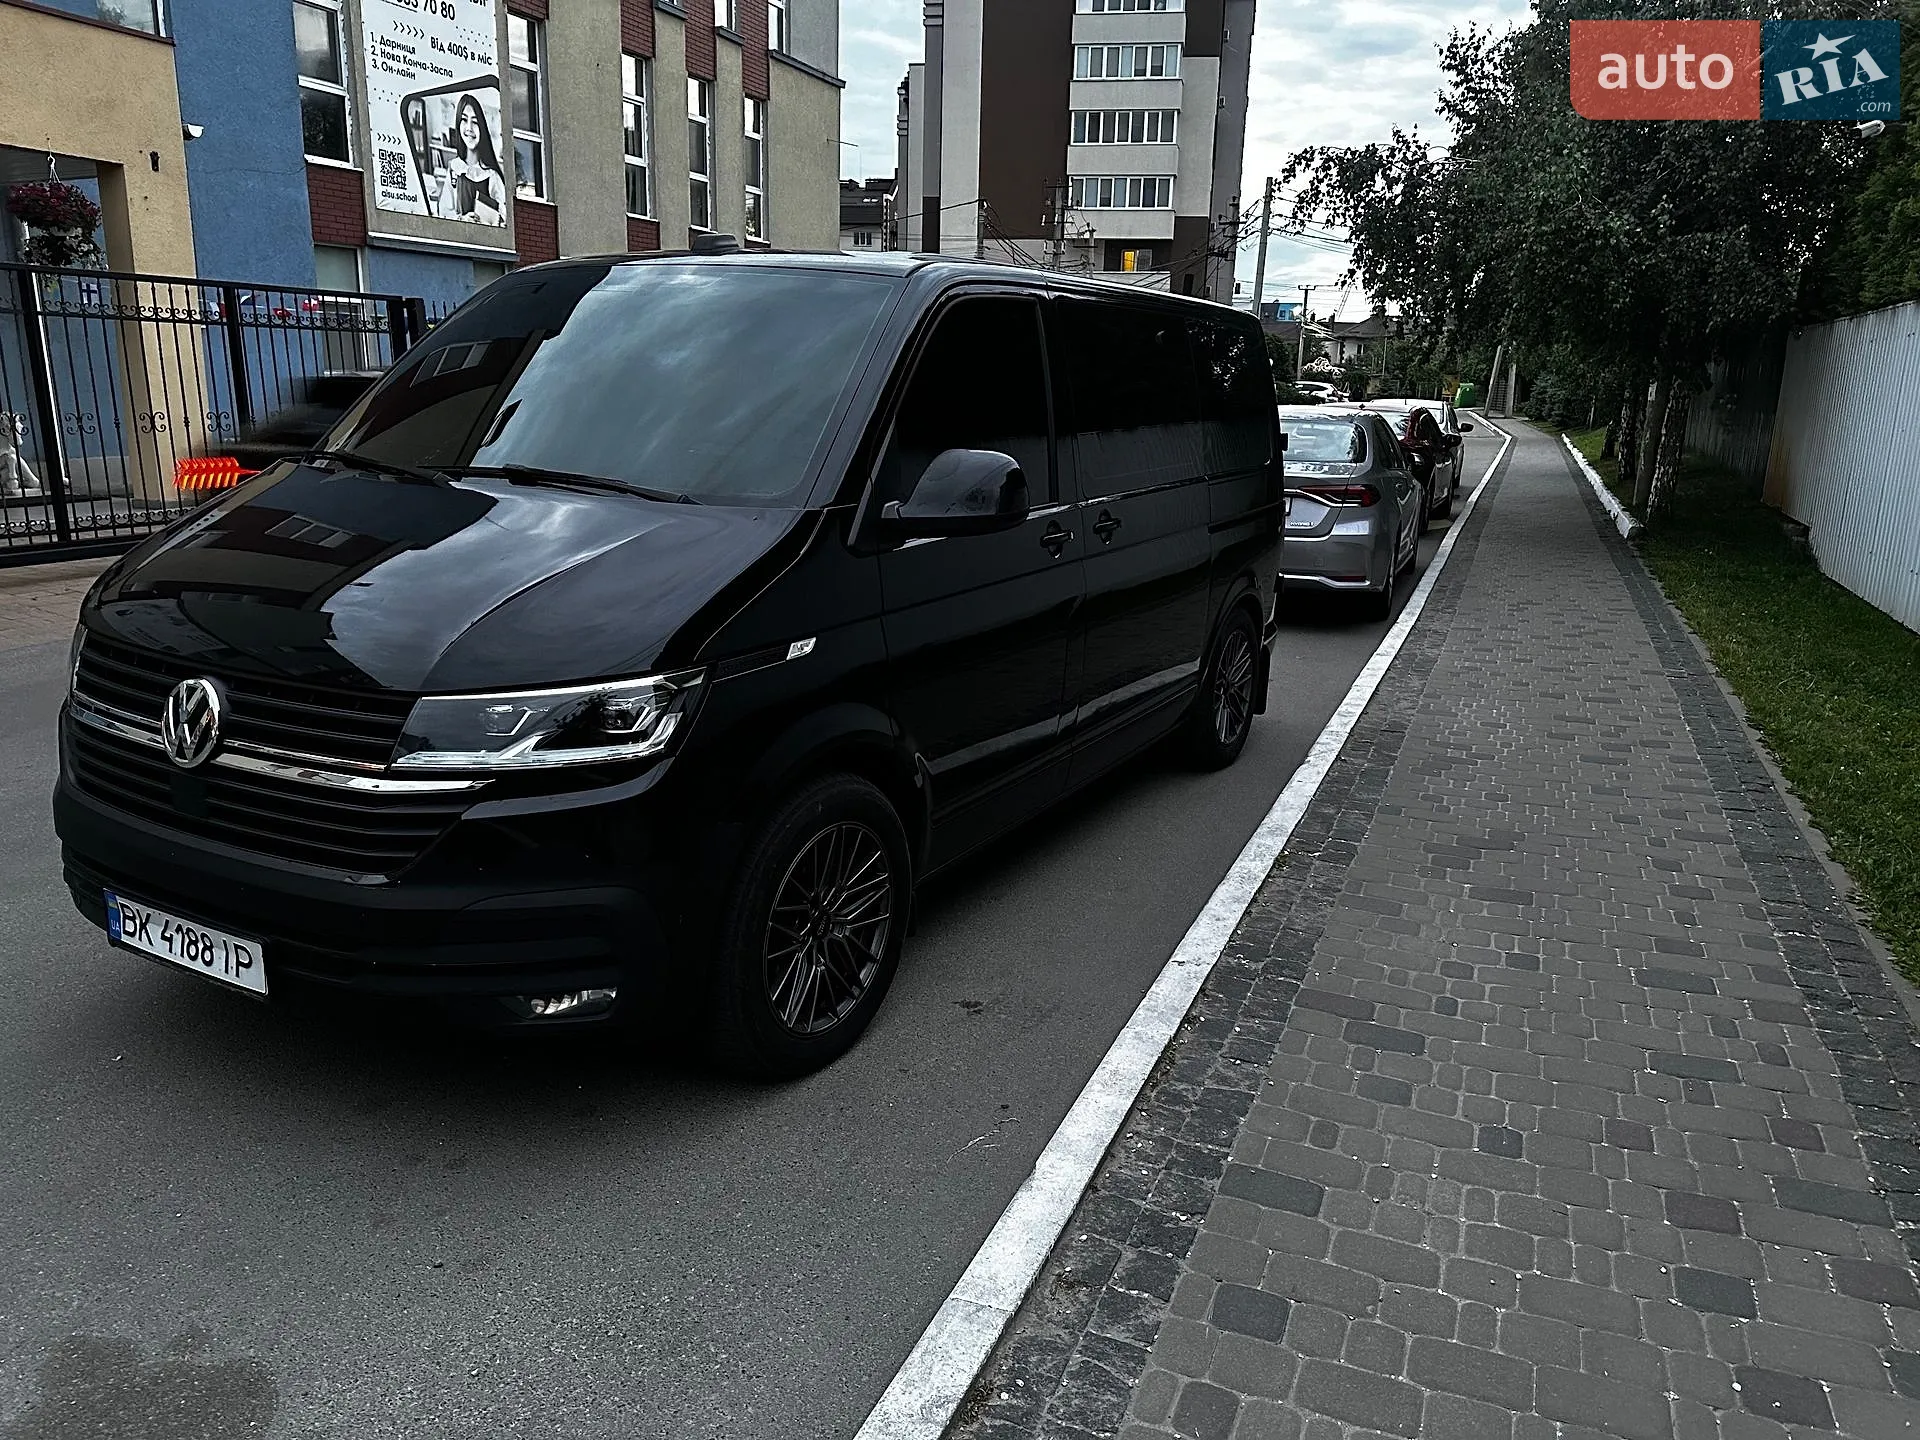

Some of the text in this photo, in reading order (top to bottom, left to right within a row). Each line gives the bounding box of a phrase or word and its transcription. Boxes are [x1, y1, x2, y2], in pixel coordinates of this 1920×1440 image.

[440, 1, 455, 20] 80
[370, 32, 416, 55] 1. Дарниця
[430, 36, 493, 66] Від 400$ в міс
[370, 45, 454, 78] 2. Нова Конча-Заспа
[372, 58, 416, 81] 3. Он-лайн
[110, 918, 121, 932] UA
[119, 901, 253, 978] BK 4188 IP
